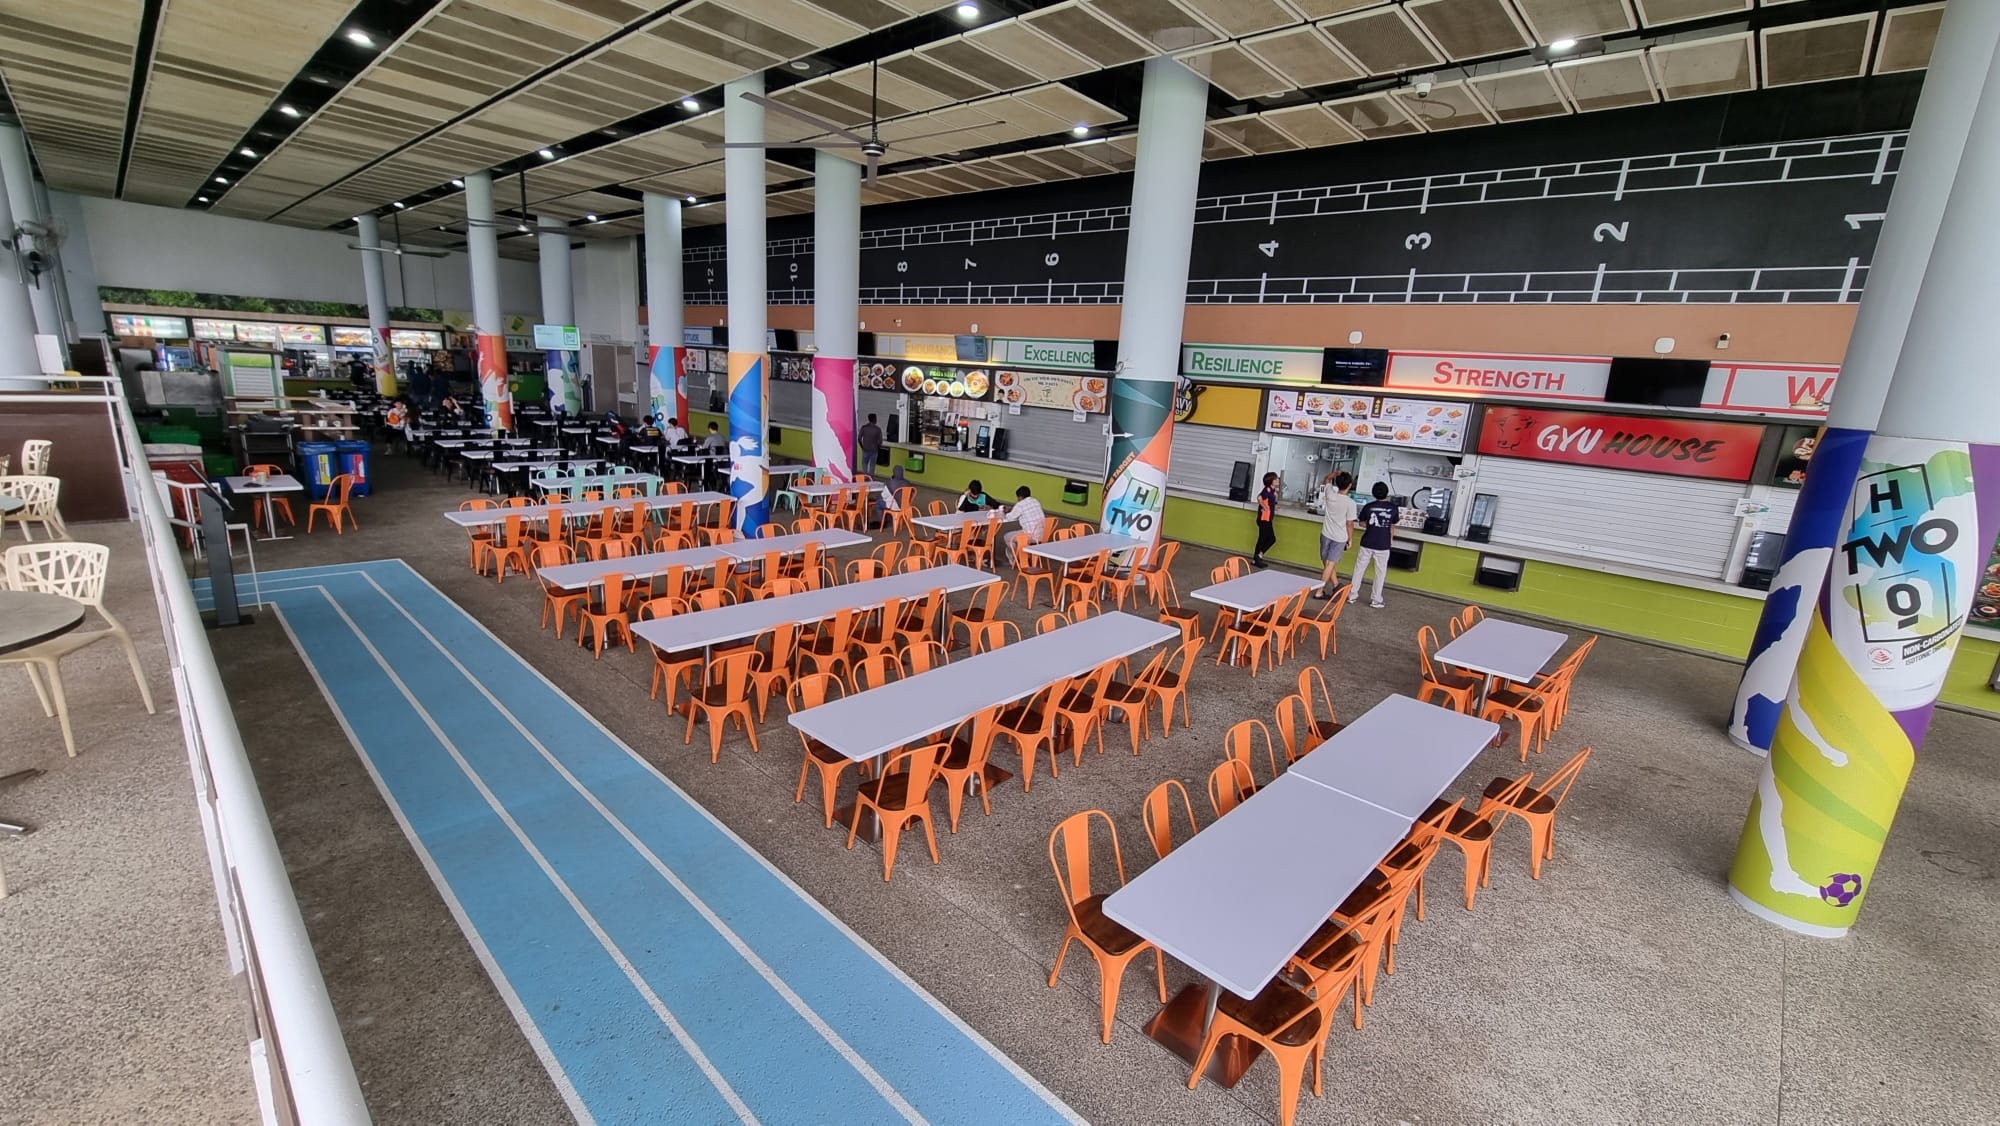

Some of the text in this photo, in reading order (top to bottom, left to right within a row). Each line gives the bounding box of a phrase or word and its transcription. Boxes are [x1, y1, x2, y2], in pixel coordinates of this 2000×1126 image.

[1844, 212, 1886, 229] 1
[1405, 232, 1432, 250] 3
[1593, 221, 1630, 242] 2
[1258, 240, 1279, 258] 4
[897, 261, 908, 272] 8
[964, 258, 977, 270] 7
[1045, 252, 1060, 266] 6
[707, 267, 714, 285] 12
[790, 263, 798, 282] 10
[905, 339, 955, 354] ENDURANC
[1024, 344, 1095, 364] EXCELLENCE
[1191, 351, 1283, 375] RESILIENCE
[1433, 361, 1565, 391] STRENGTH
[1536, 424, 1725, 463] GYU HOUSE
[1112, 451, 1136, 479] TARGET
[1133, 486, 1150, 505] H
[1870, 479, 1903, 514] H
[1110, 507, 1153, 531] TWO
[1841, 518, 1959, 576] TWO
